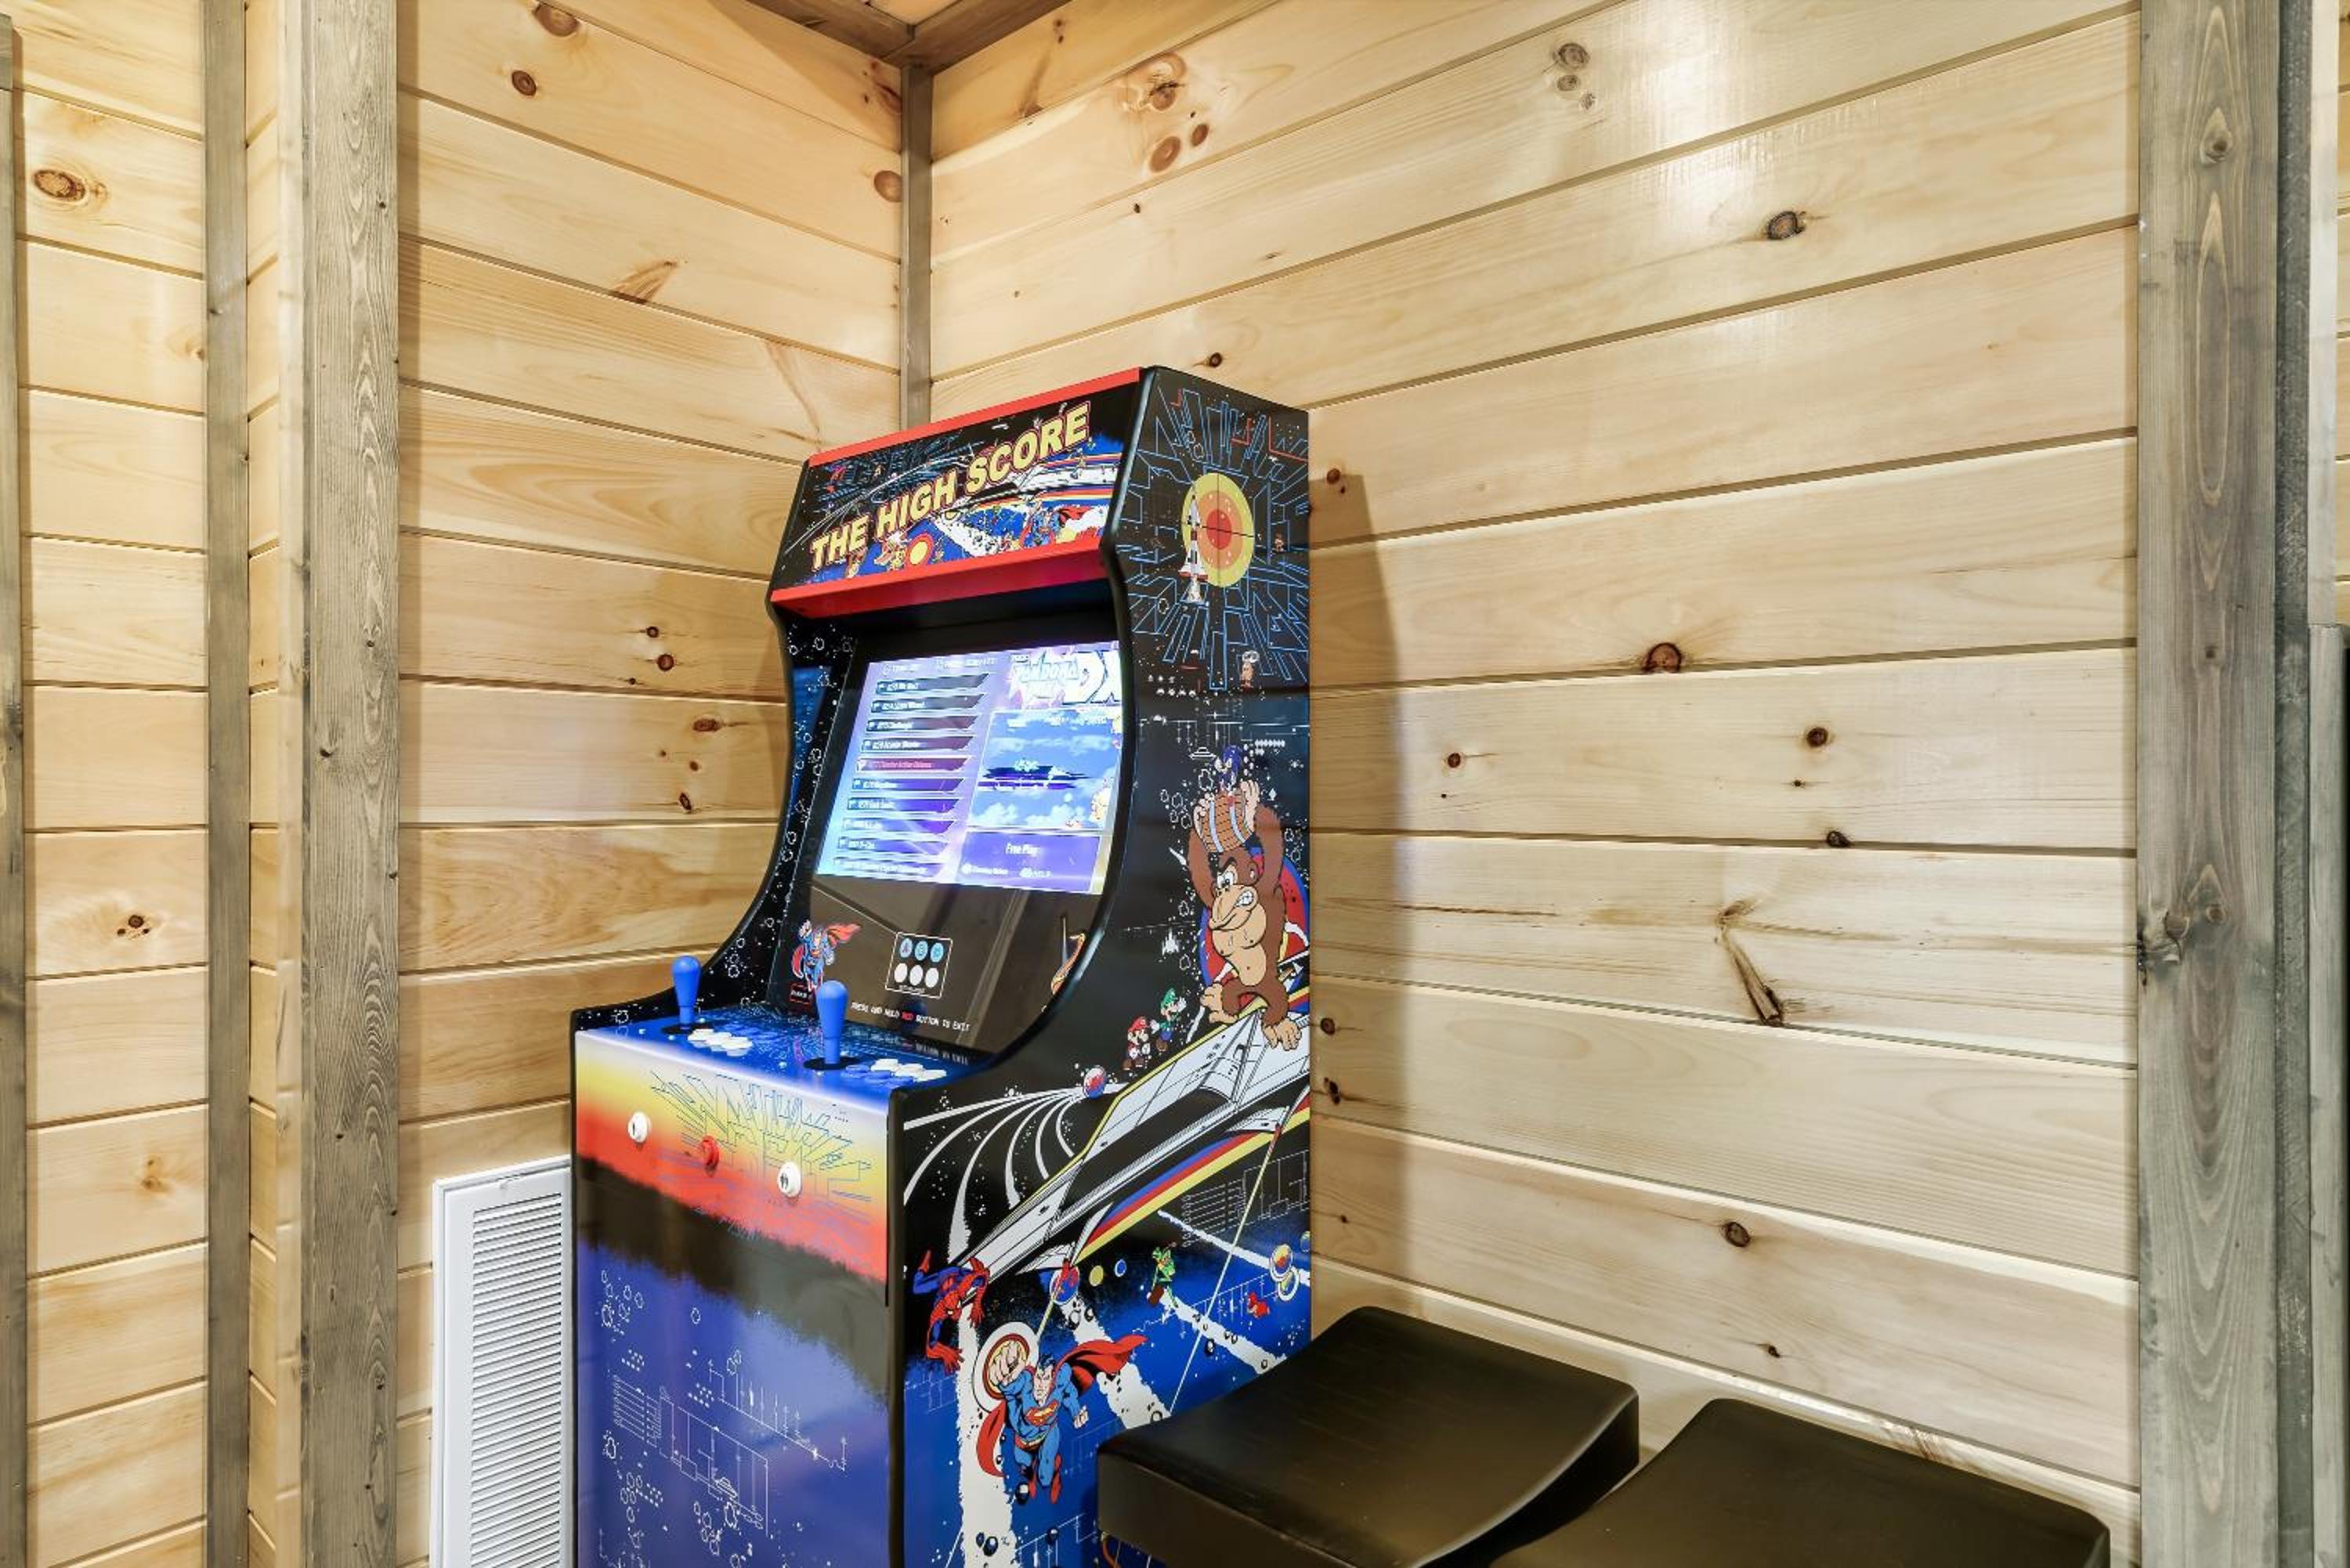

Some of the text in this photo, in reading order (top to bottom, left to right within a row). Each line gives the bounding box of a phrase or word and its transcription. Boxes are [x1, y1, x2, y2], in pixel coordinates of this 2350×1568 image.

[810, 400, 1091, 572] THE HIGH SCORE
[851, 1002, 971, 1031] PRESS AND HOLD RED BUTTON TO EXIT
